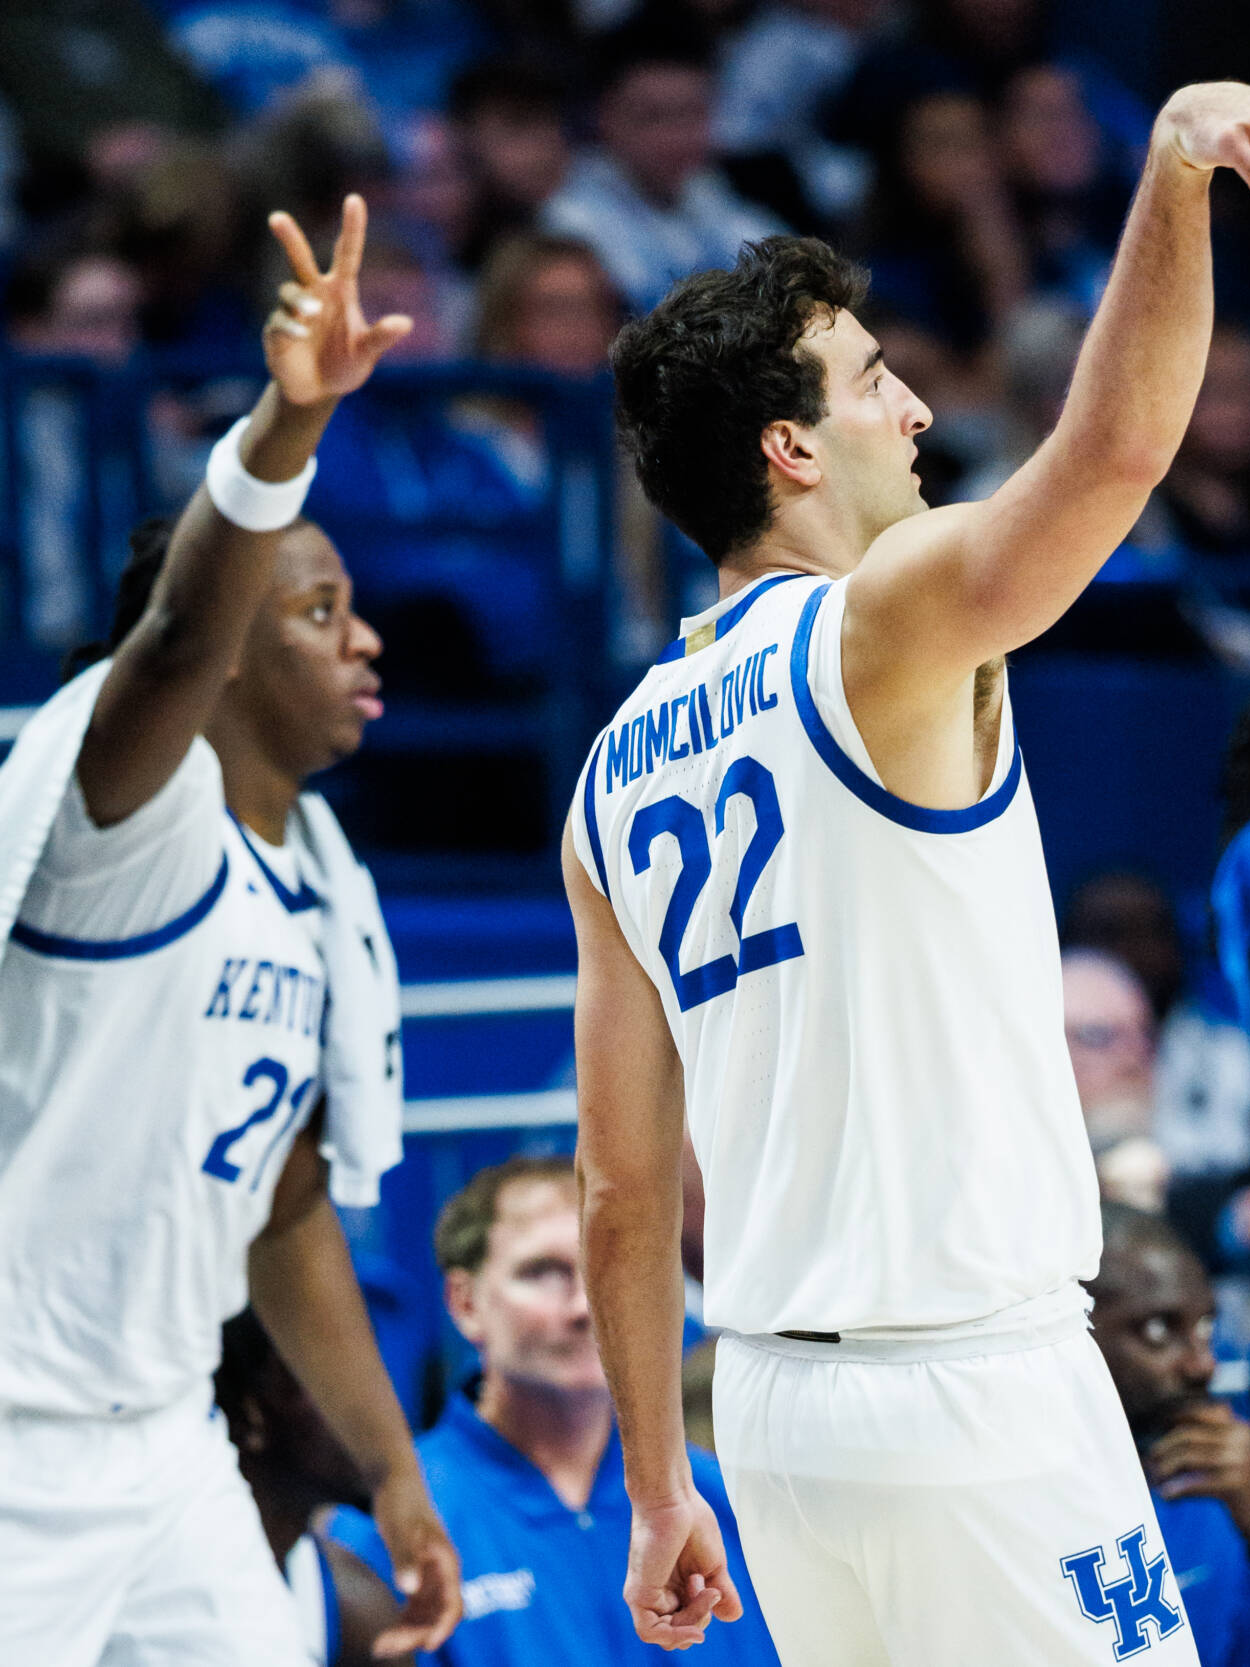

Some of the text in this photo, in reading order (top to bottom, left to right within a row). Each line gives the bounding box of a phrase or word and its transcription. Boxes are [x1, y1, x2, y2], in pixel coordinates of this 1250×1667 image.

[605, 643, 779, 795] MOMCILOVIC
[628, 755, 805, 1013] 22
[1059, 1523, 1185, 1663] UK
